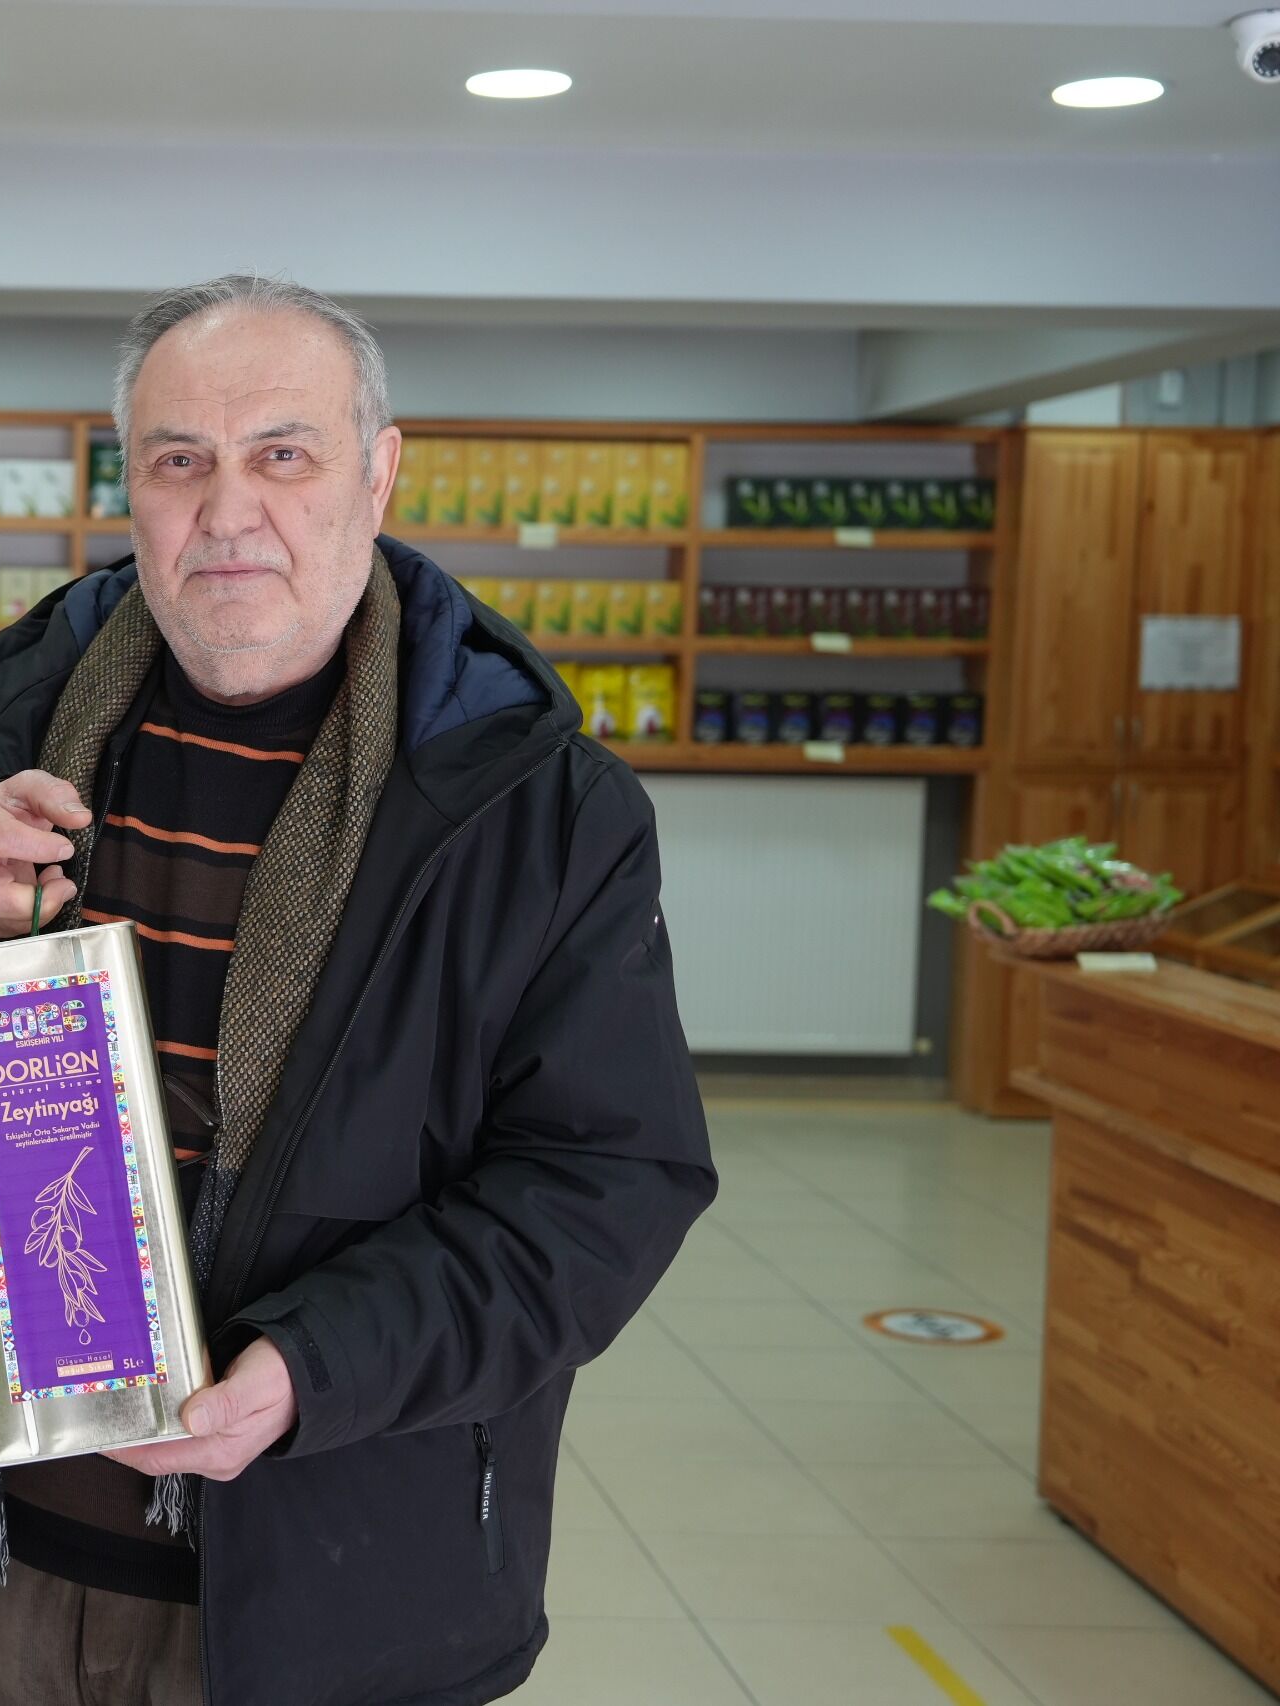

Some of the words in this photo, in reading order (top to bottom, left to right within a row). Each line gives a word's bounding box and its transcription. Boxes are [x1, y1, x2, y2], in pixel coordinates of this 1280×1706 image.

[0, 1092, 100, 1126] Zeytinyağı
[33, 1128, 51, 1137] Orta
[52, 1124, 80, 1136] Sakarya
[482, 1472, 492, 1520] HILFIGER
